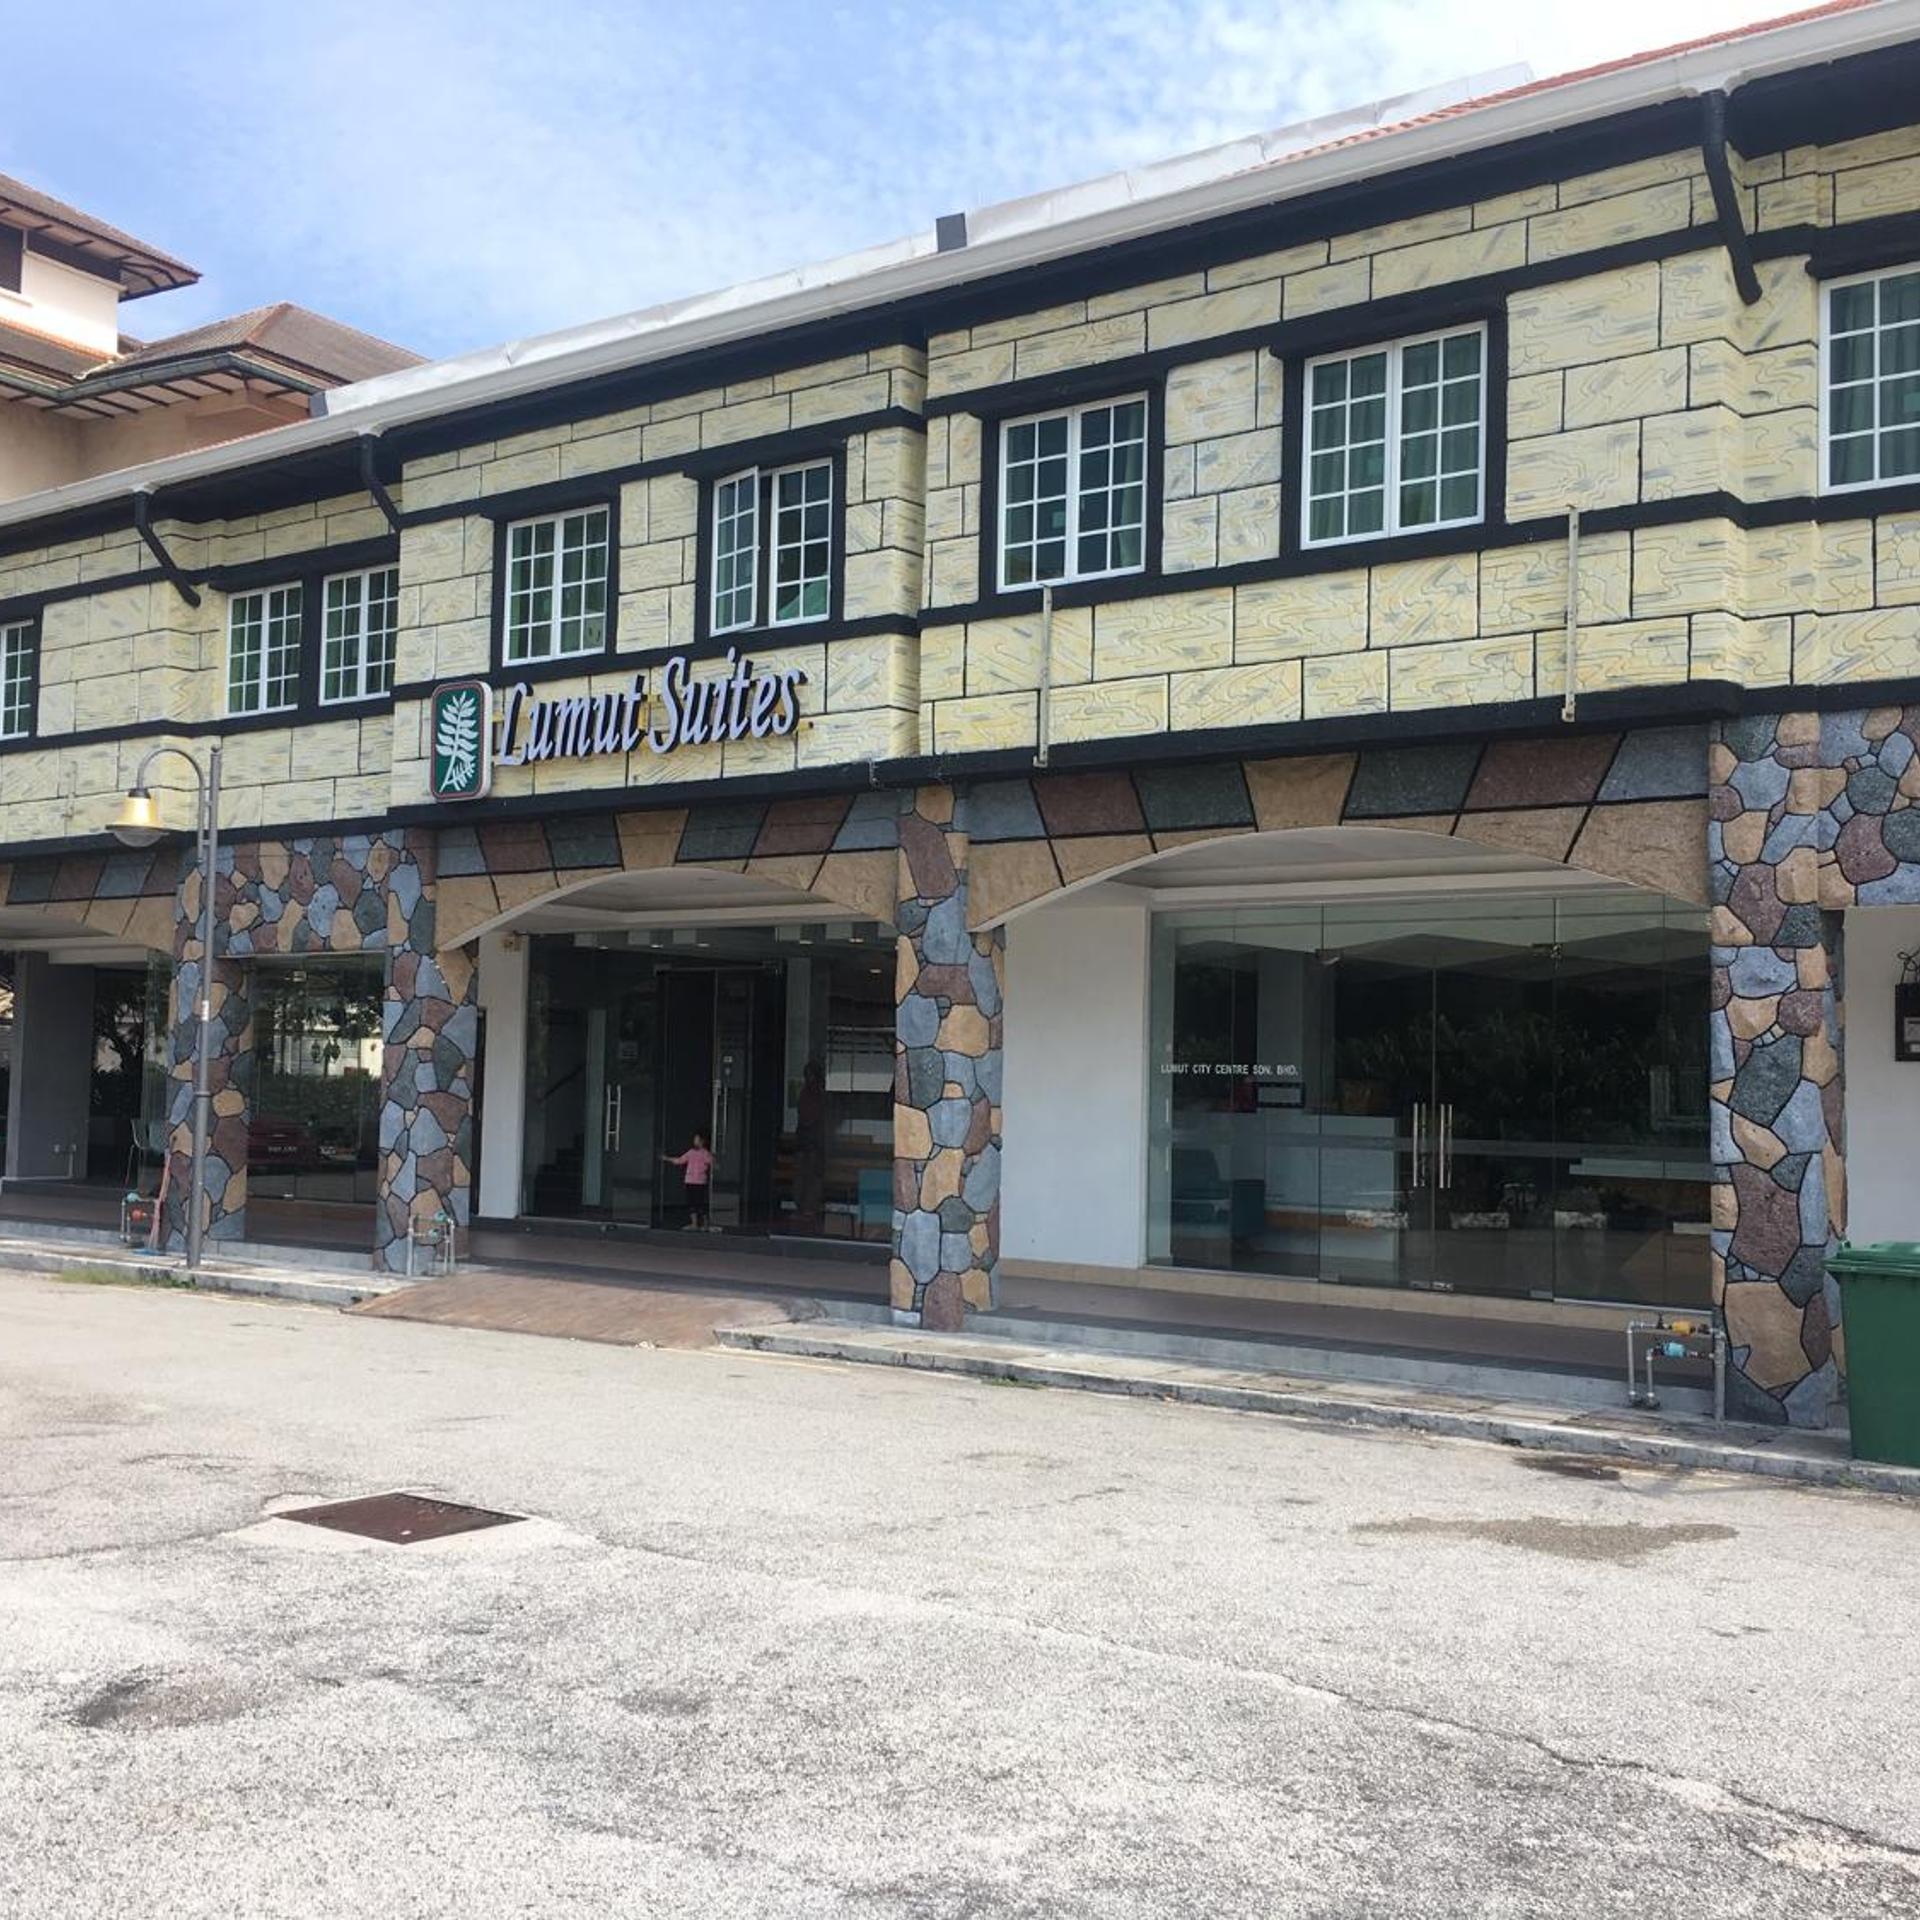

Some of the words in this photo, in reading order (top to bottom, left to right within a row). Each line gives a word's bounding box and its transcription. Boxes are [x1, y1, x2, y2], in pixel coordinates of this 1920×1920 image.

[499, 675, 646, 766] Lumut
[649, 647, 807, 754] Suites
[1192, 1063, 1211, 1075] CITY
[1215, 1063, 1249, 1075] CENTRE
